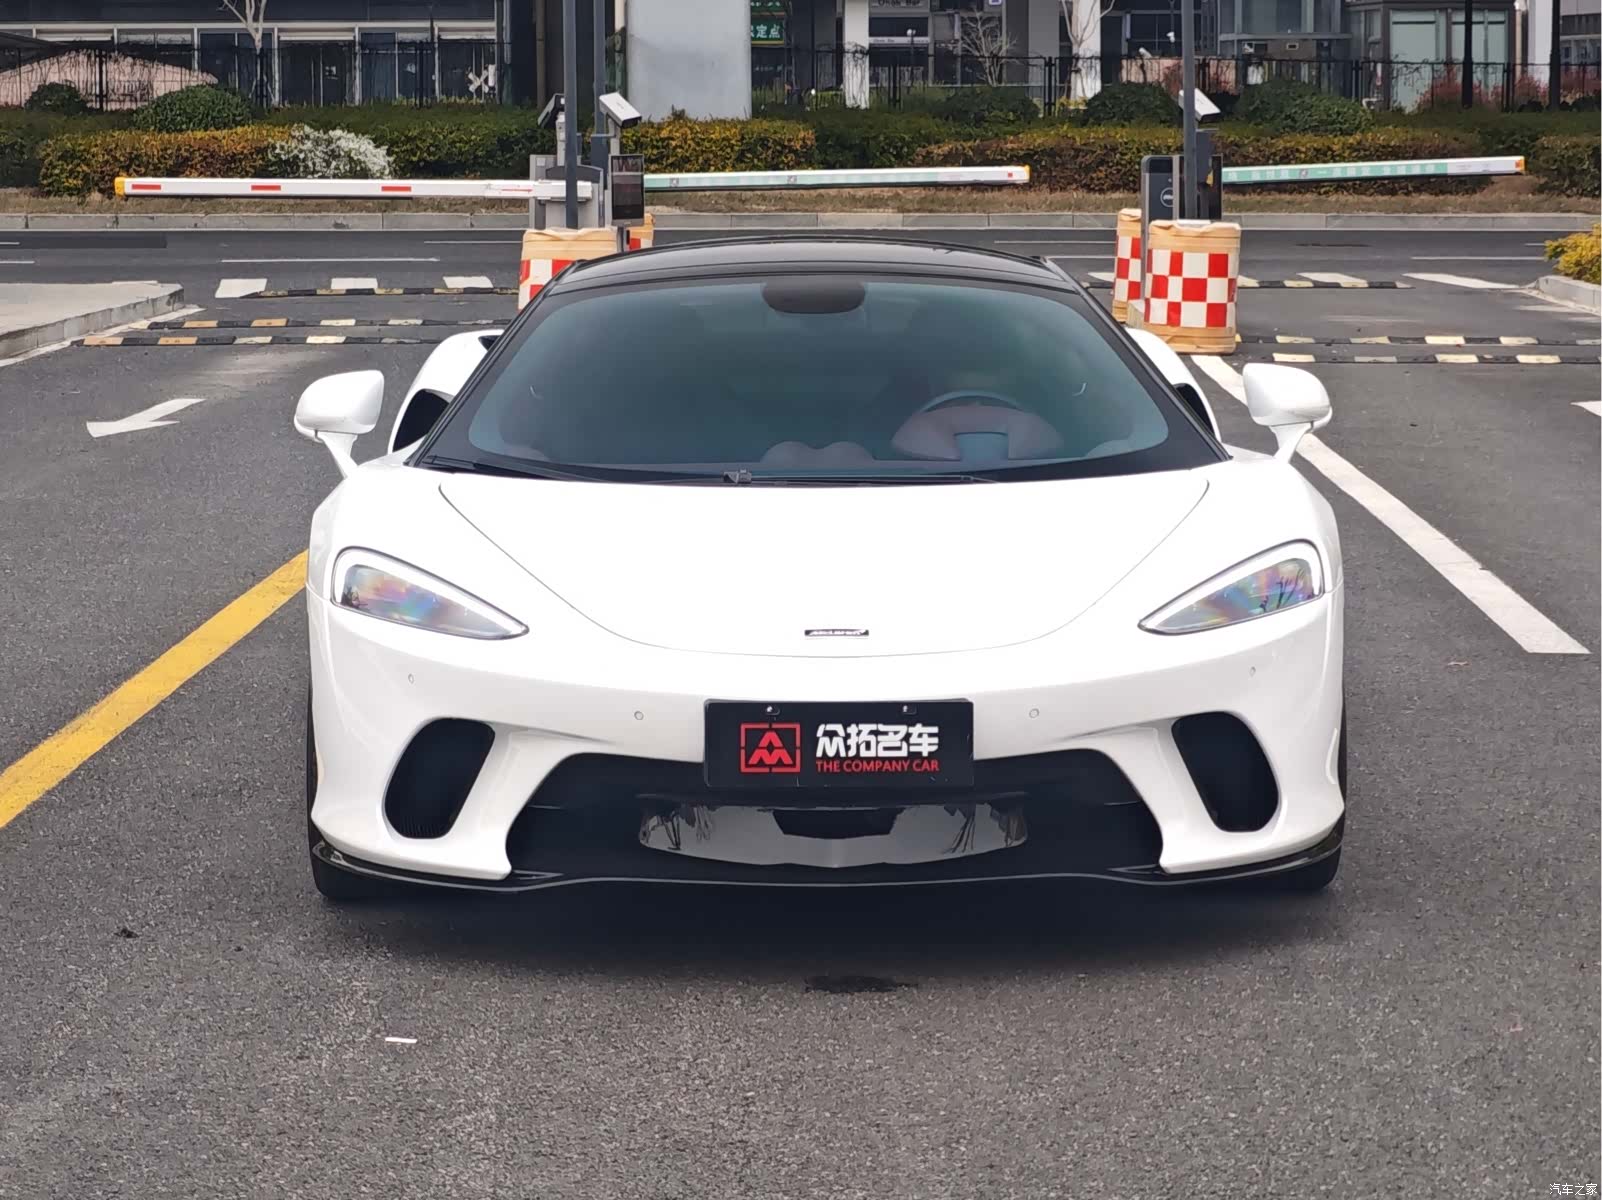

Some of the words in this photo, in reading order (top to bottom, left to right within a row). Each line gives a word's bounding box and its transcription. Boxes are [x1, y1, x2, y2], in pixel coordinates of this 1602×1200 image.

[816, 723, 939, 757] 众拓名车
[816, 760, 840, 772] THE
[843, 760, 909, 772] COMPANY
[913, 760, 939, 772] CAR
